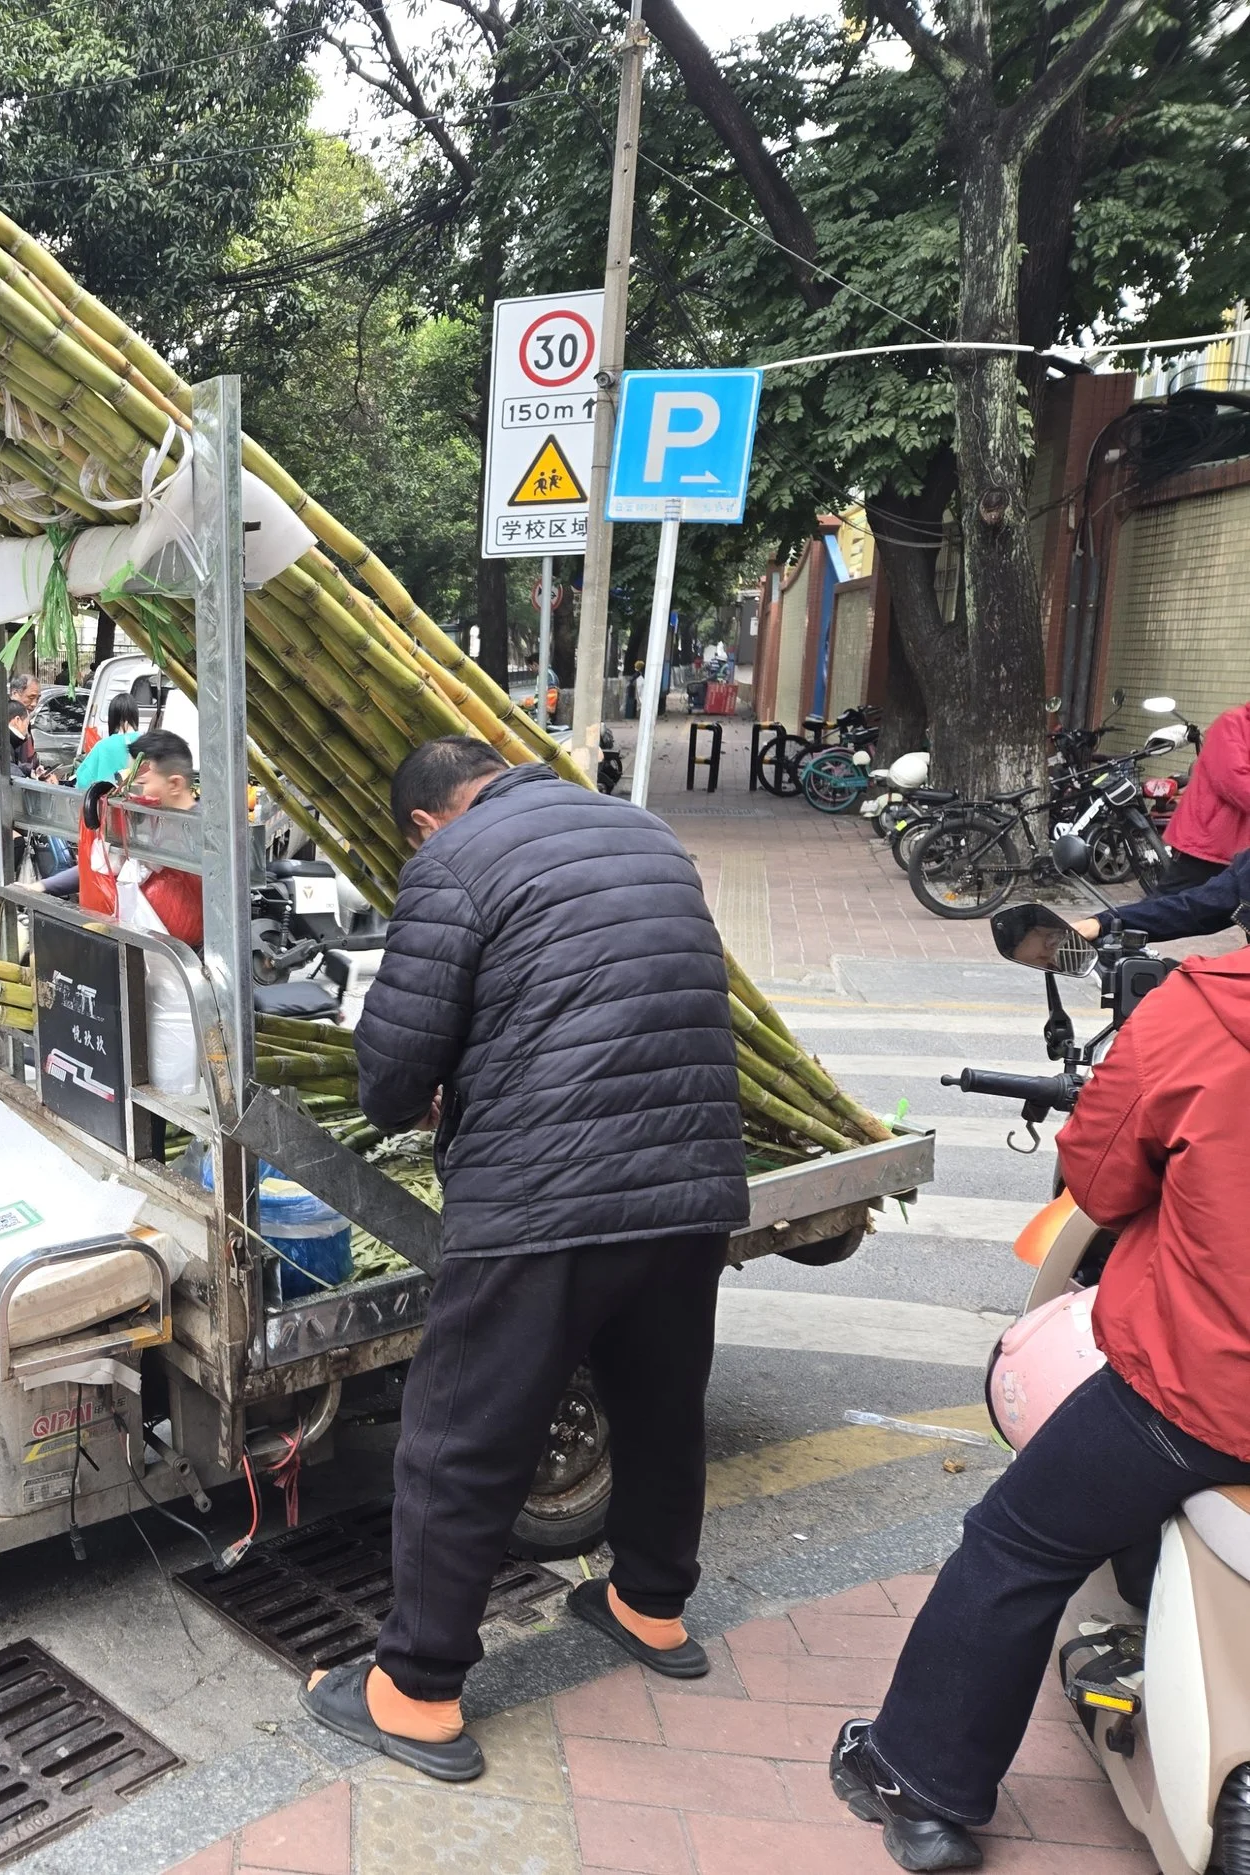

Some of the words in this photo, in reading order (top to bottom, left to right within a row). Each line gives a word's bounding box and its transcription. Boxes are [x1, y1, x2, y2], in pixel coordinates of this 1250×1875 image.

[533, 333, 578, 370] 30
[509, 402, 574, 422] 150m
[643, 391, 721, 483] P
[501, 518, 588, 540] 学校区域
[31, 1402, 93, 1438] QIPAI
[25, 1813, 54, 1832] 600
